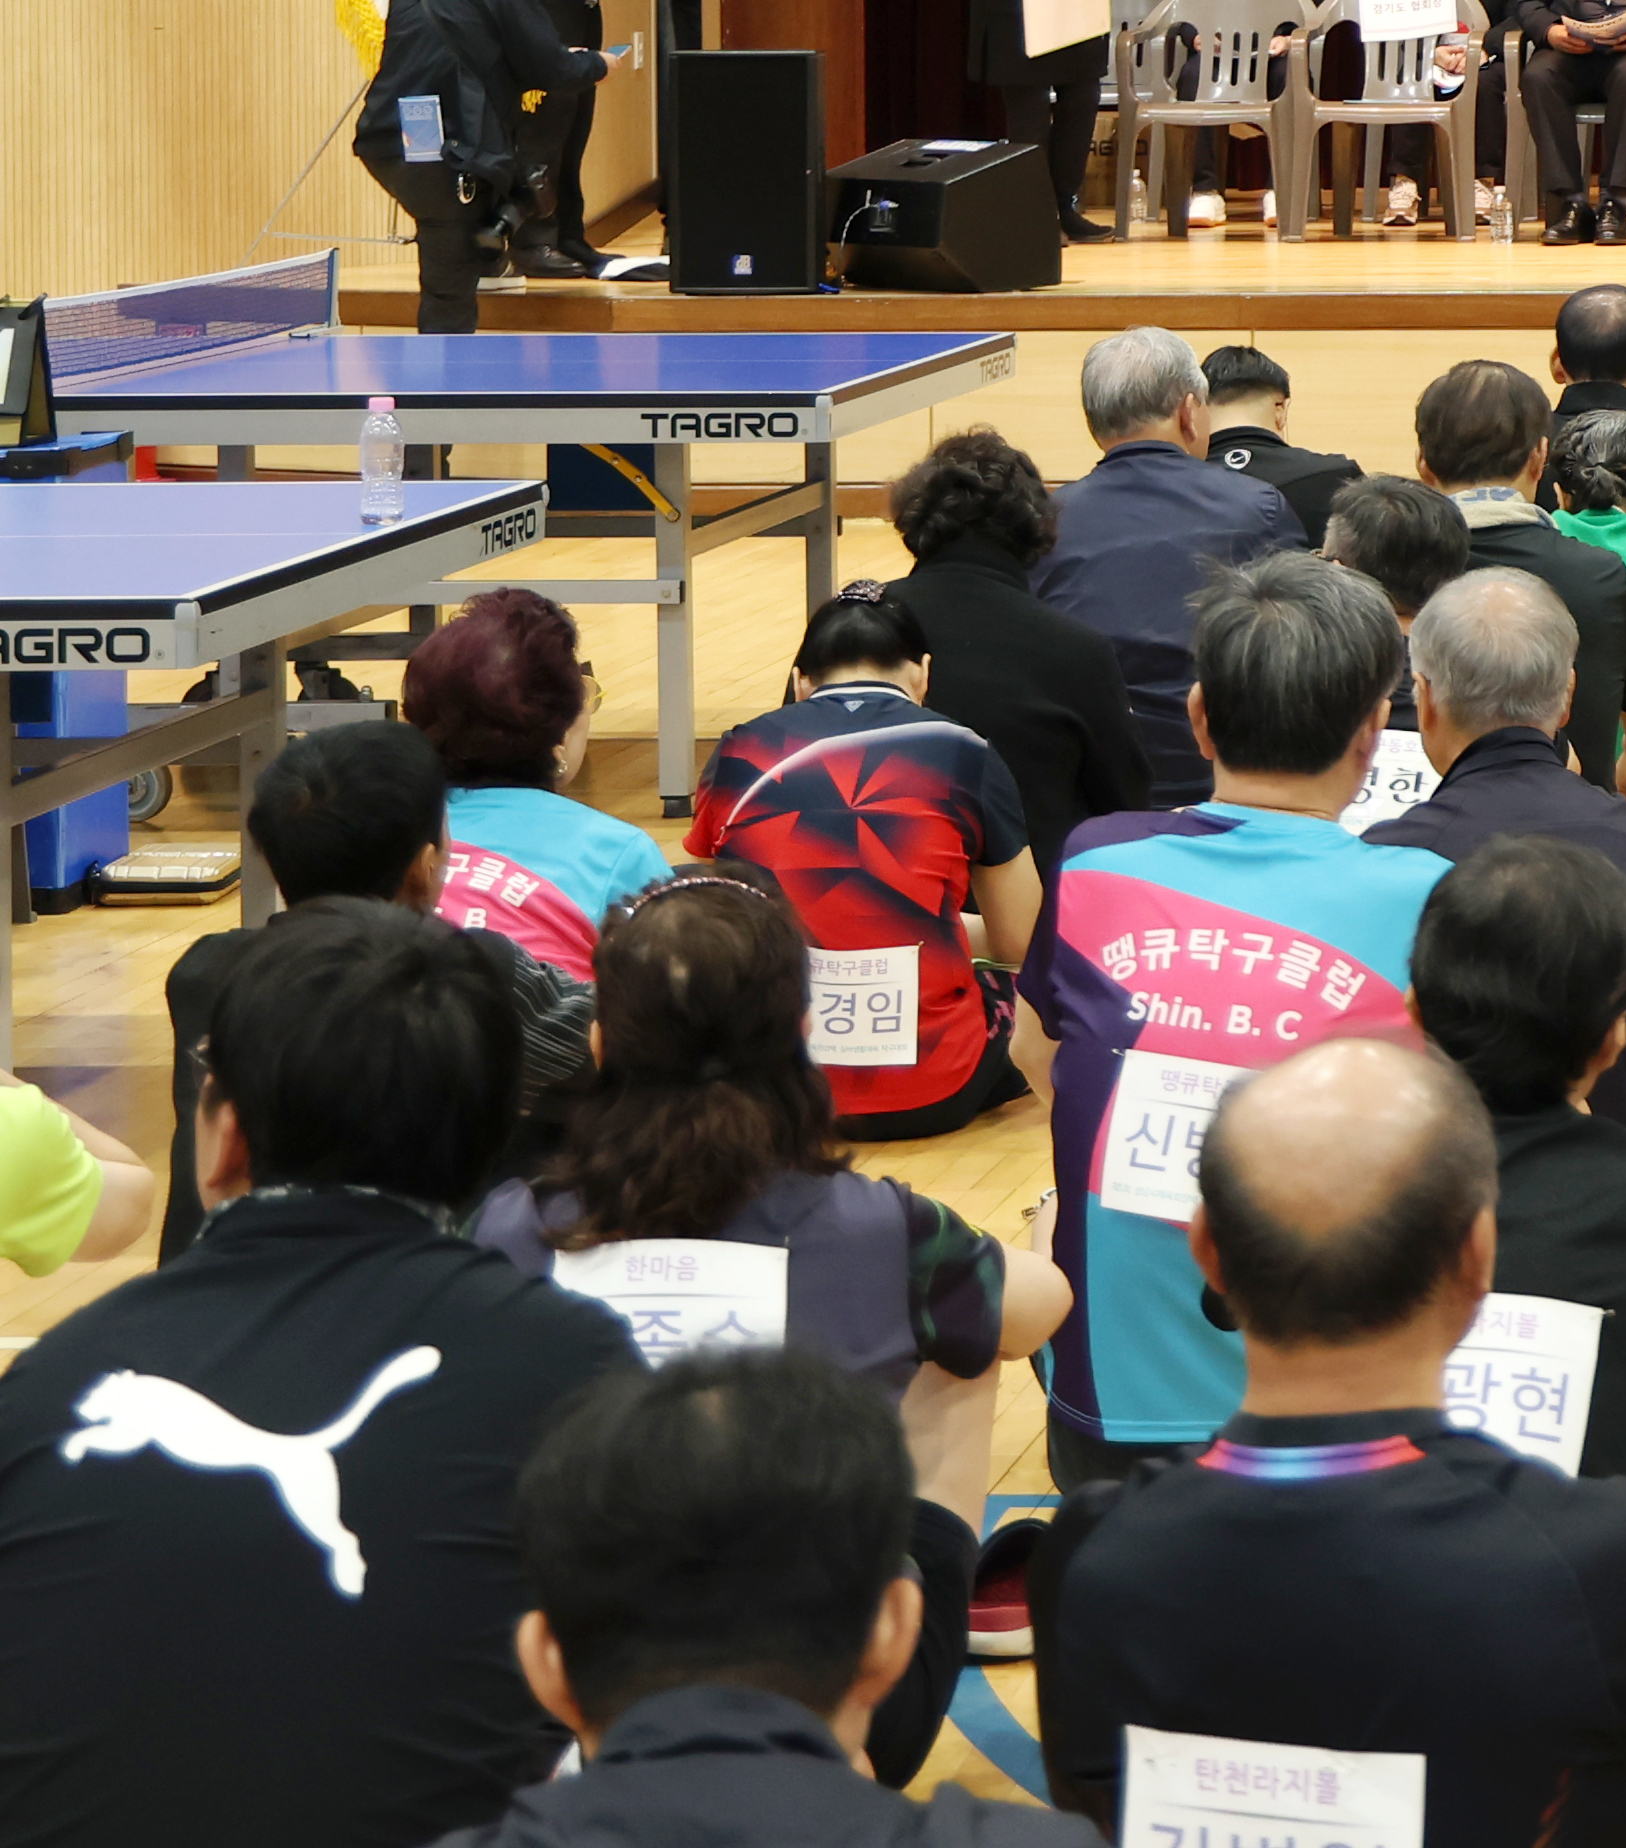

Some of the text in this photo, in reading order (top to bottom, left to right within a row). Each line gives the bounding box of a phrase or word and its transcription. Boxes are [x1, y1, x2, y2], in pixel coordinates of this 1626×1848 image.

[640, 413, 798, 439] TAGRO
[481, 508, 537, 556] TAGRO
[0, 627, 151, 664] GRO
[445, 852, 540, 908] 구클럽
[811, 957, 888, 977] 큐탁구클럽
[1102, 928, 1368, 1011] 땡큐탁구클럽
[818, 989, 903, 1035] 경임
[1126, 990, 1303, 1041] Shin. B. C
[625, 1255, 700, 1282] 한마음
[1445, 1362, 1570, 1444] 광현
[1194, 1757, 1341, 1806] 탄천라지볼
